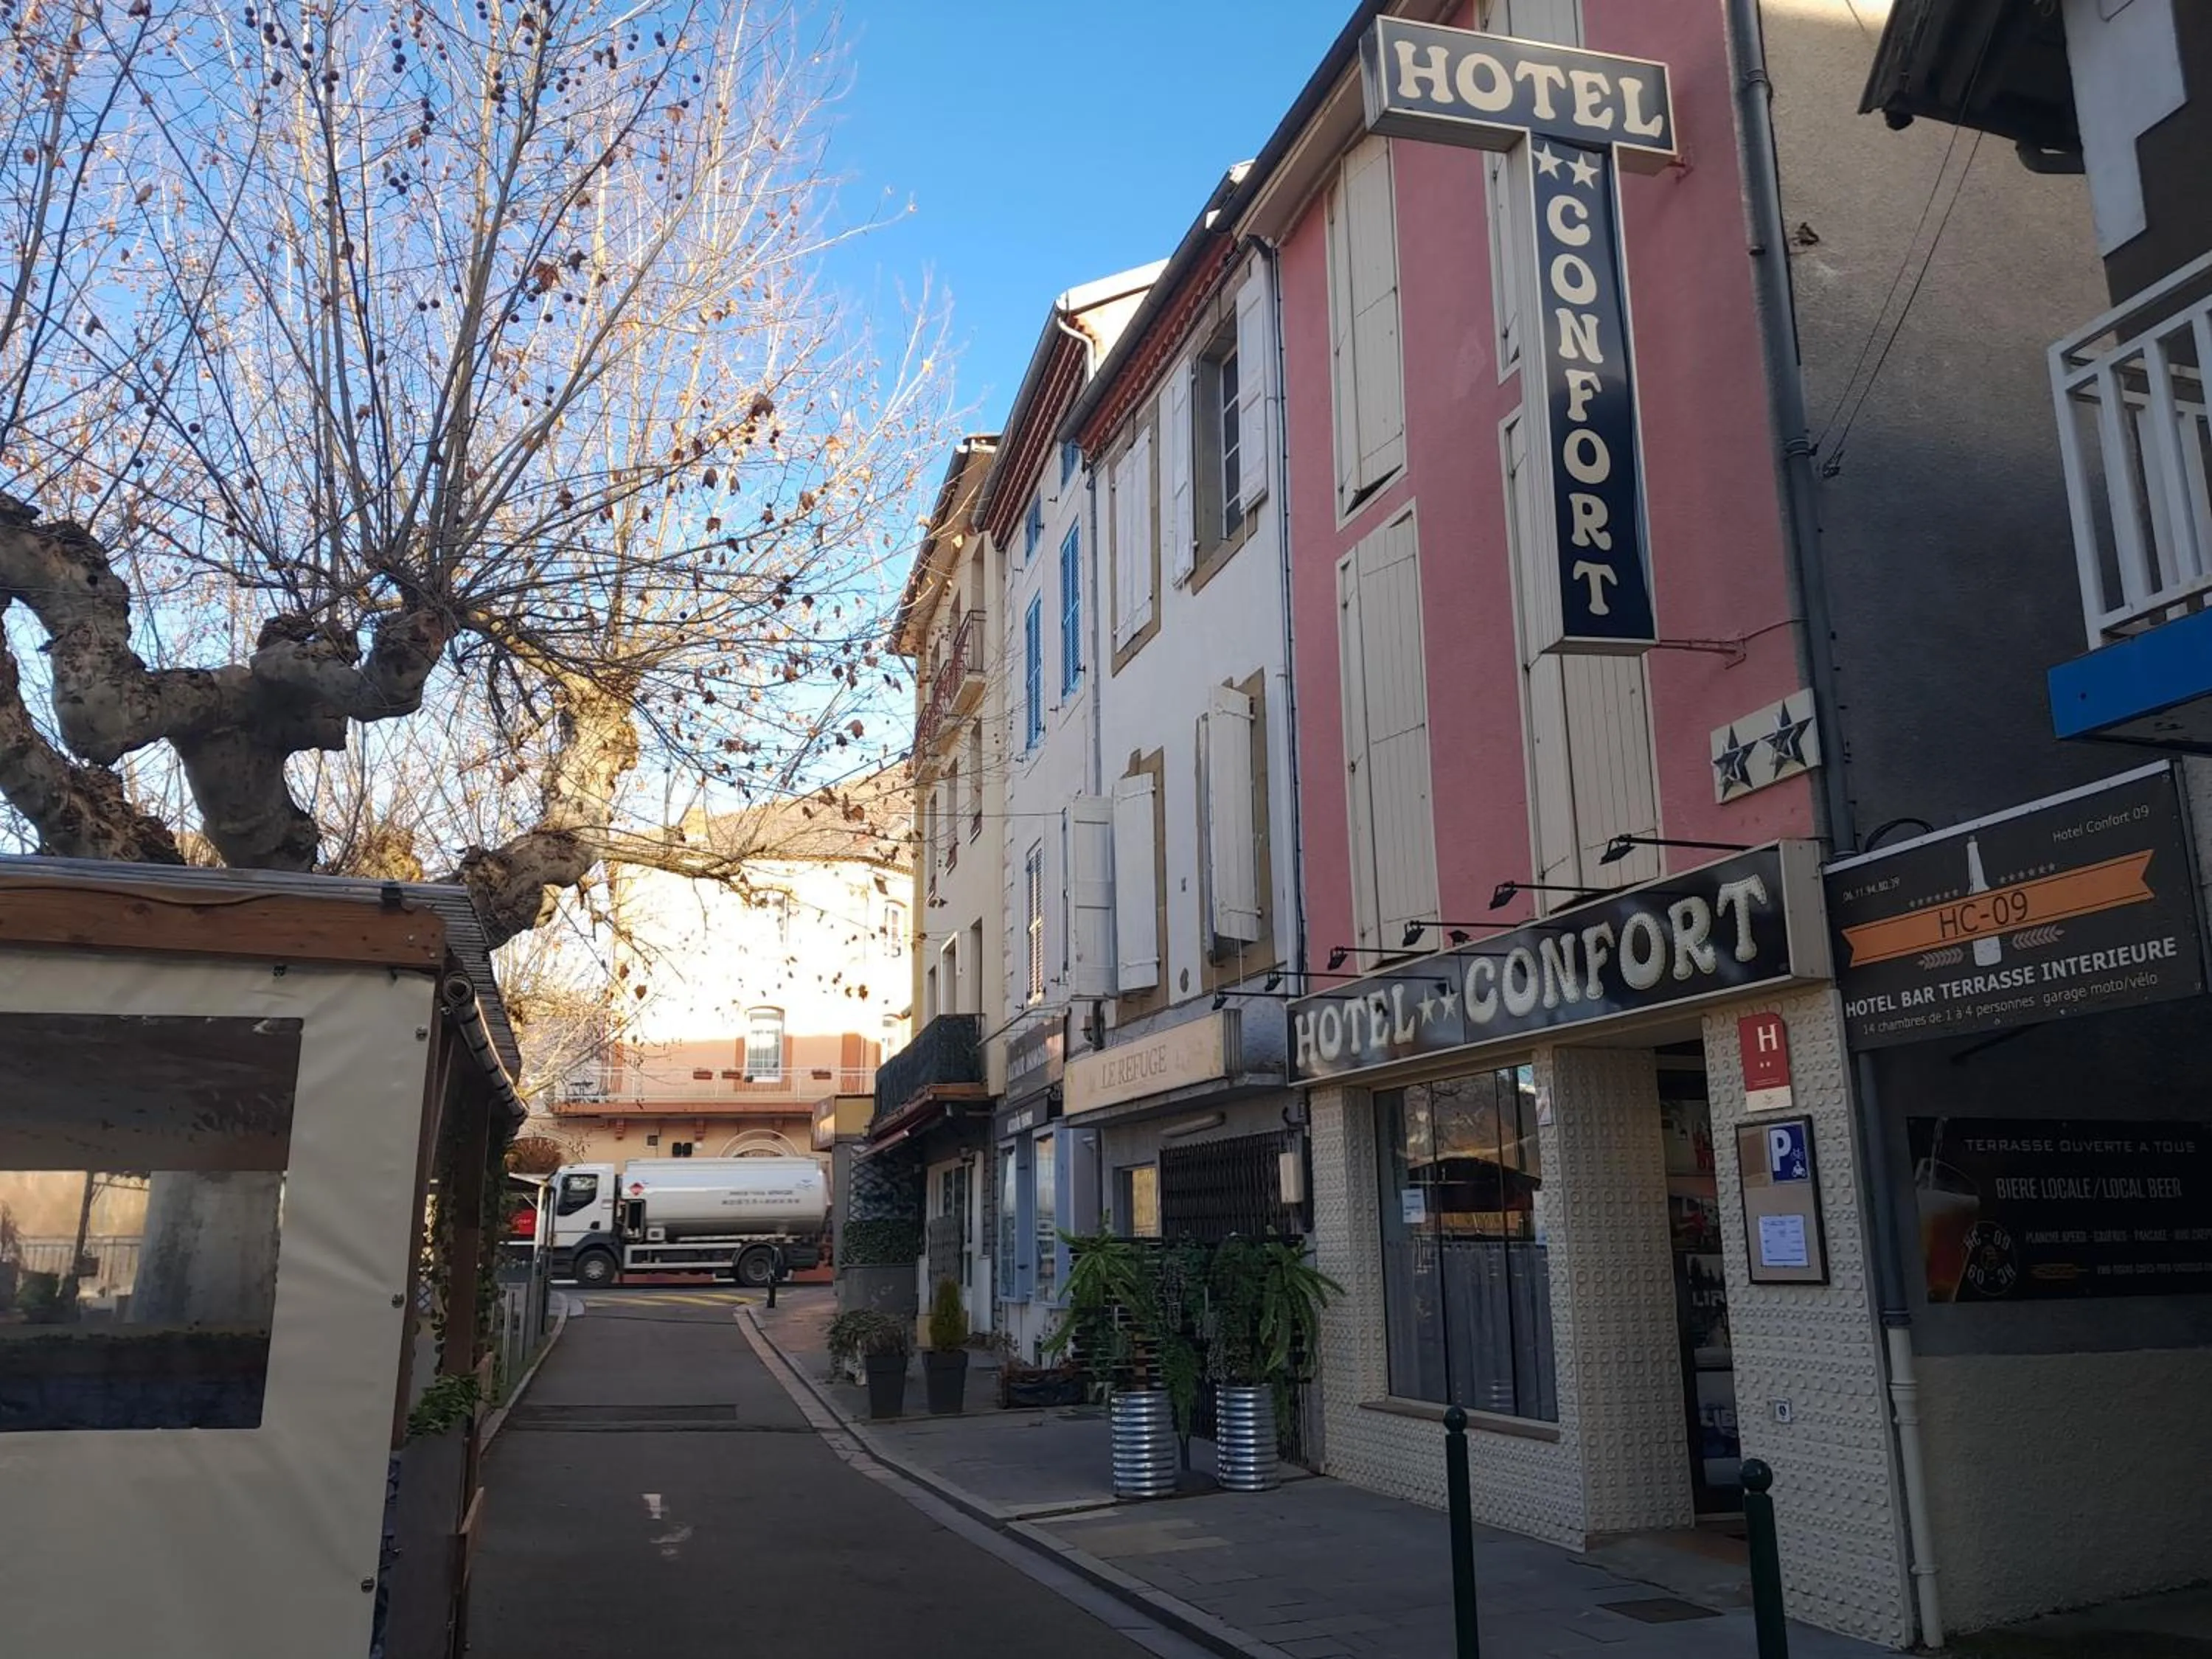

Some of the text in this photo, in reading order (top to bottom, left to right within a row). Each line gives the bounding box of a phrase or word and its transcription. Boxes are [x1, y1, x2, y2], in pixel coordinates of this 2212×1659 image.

[1394, 41, 1663, 138] HOTEL
[1546, 195, 1617, 616] CONFORT
[2053, 804, 2149, 843] Hotel Confort 09
[1939, 891, 2028, 938] HC-09
[1295, 874, 1768, 1068] HOTEL CONFORT
[1846, 937, 2177, 1018] HOTEL BAR TERRASSE INTERIEURE
[1863, 971, 2158, 1035] 14 chambres de 1 à 4 personnes garage moto/vélo
[1758, 1023, 1779, 1052] H
[1099, 1044, 1167, 1088] LE REFUGE
[1770, 1129, 1792, 1172] P
[1964, 1138, 2196, 1153] TERRASSE OUVERTE A TOUS
[1995, 1177, 2037, 1200] BIERE
[2147, 1177, 2183, 1198] BEER
